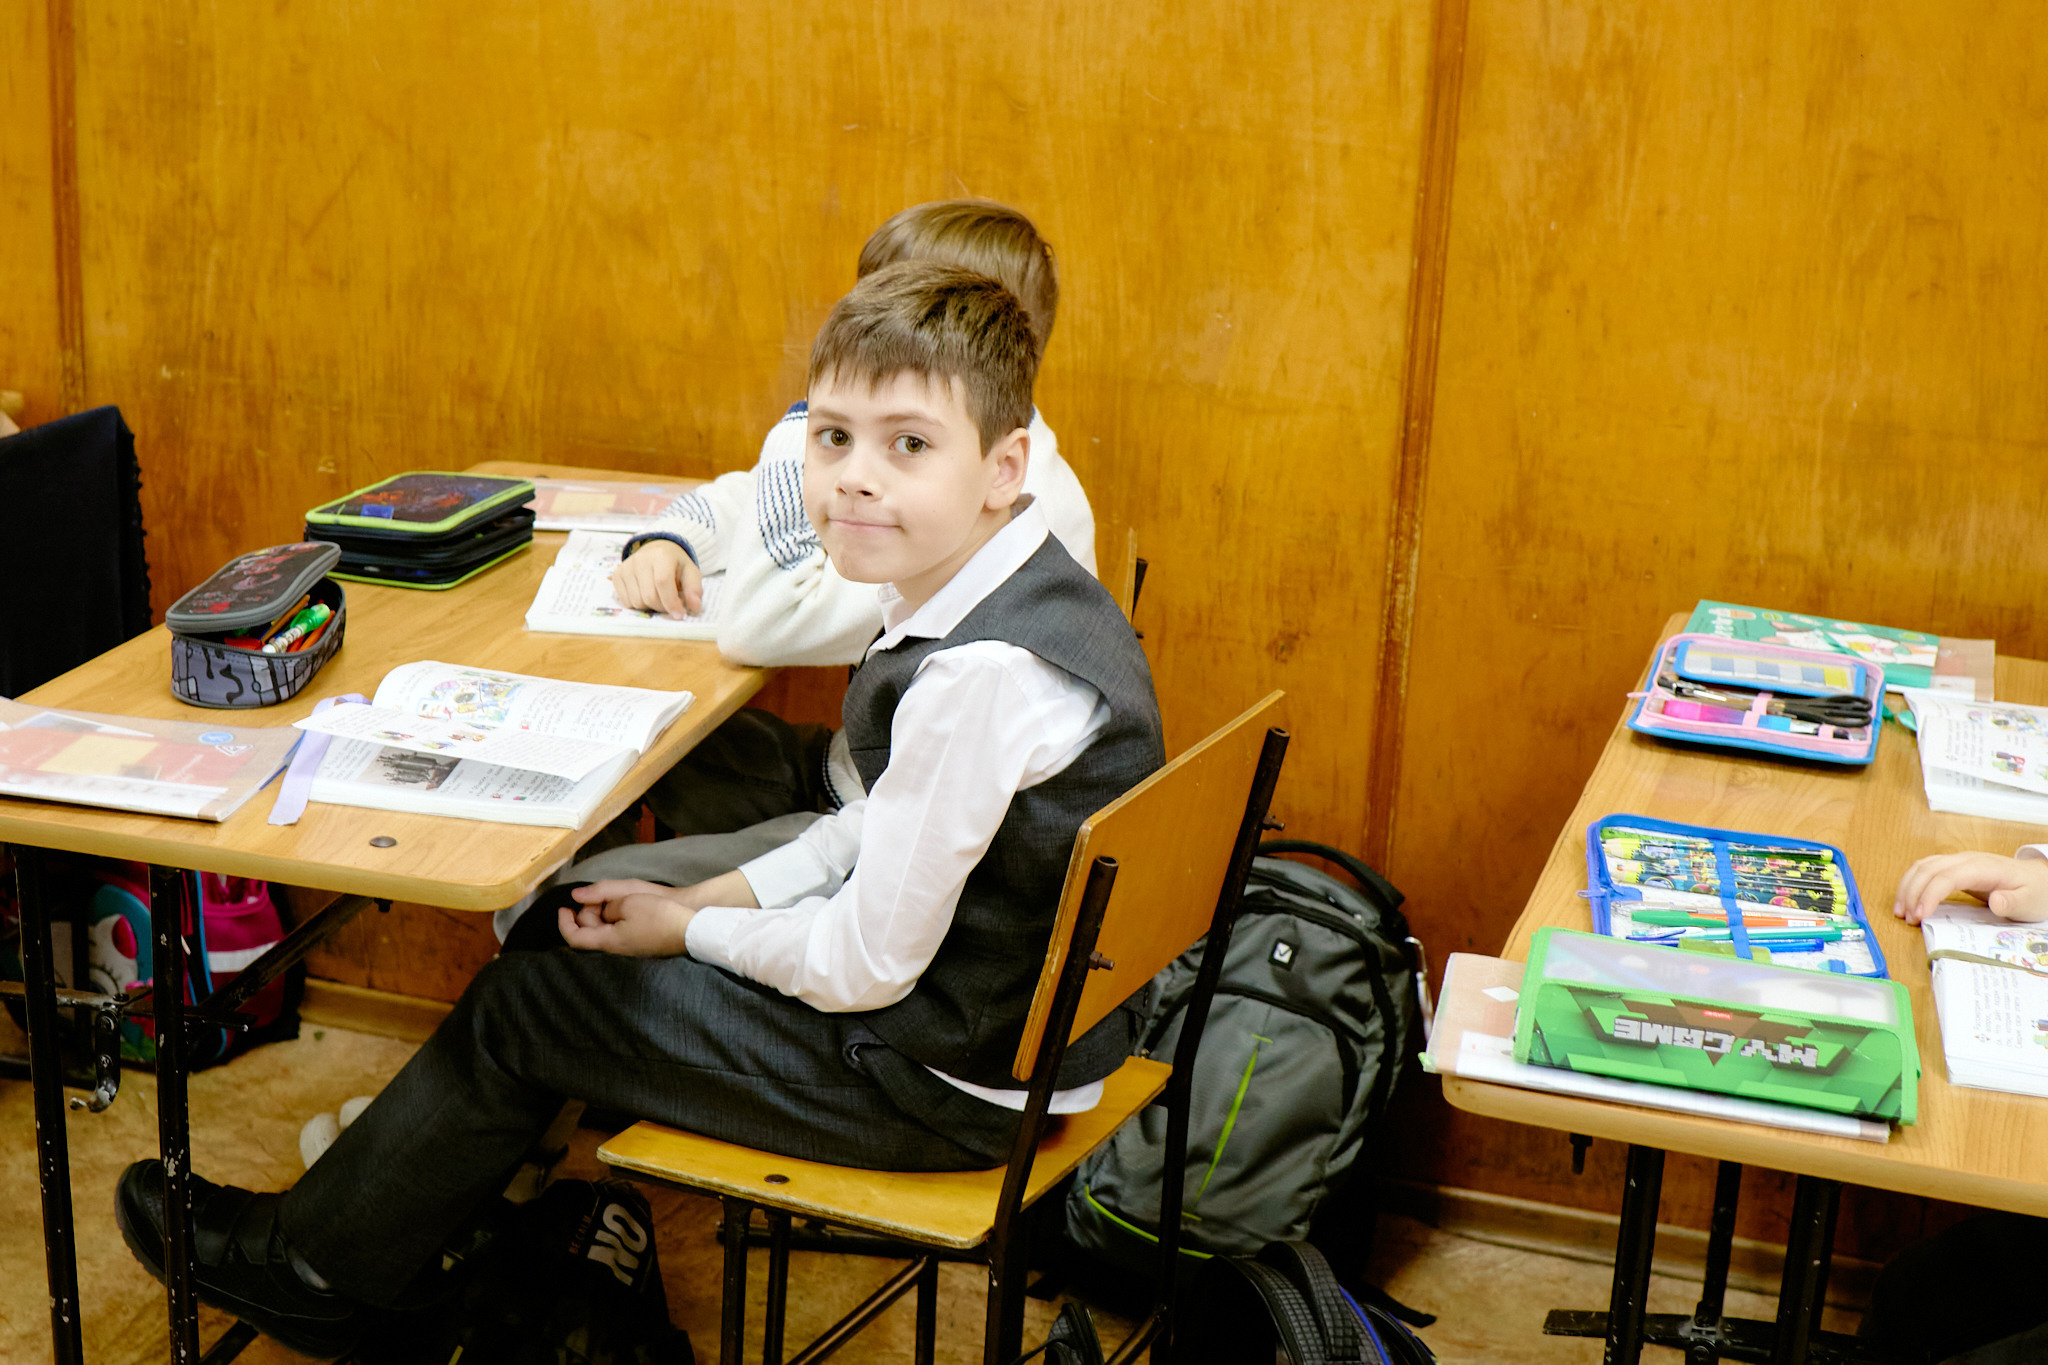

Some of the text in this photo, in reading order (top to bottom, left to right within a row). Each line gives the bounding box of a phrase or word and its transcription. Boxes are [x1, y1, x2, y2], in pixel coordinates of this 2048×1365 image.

[1613, 1017, 1818, 1068] MY GAME
[587, 1202, 648, 1287] NO
